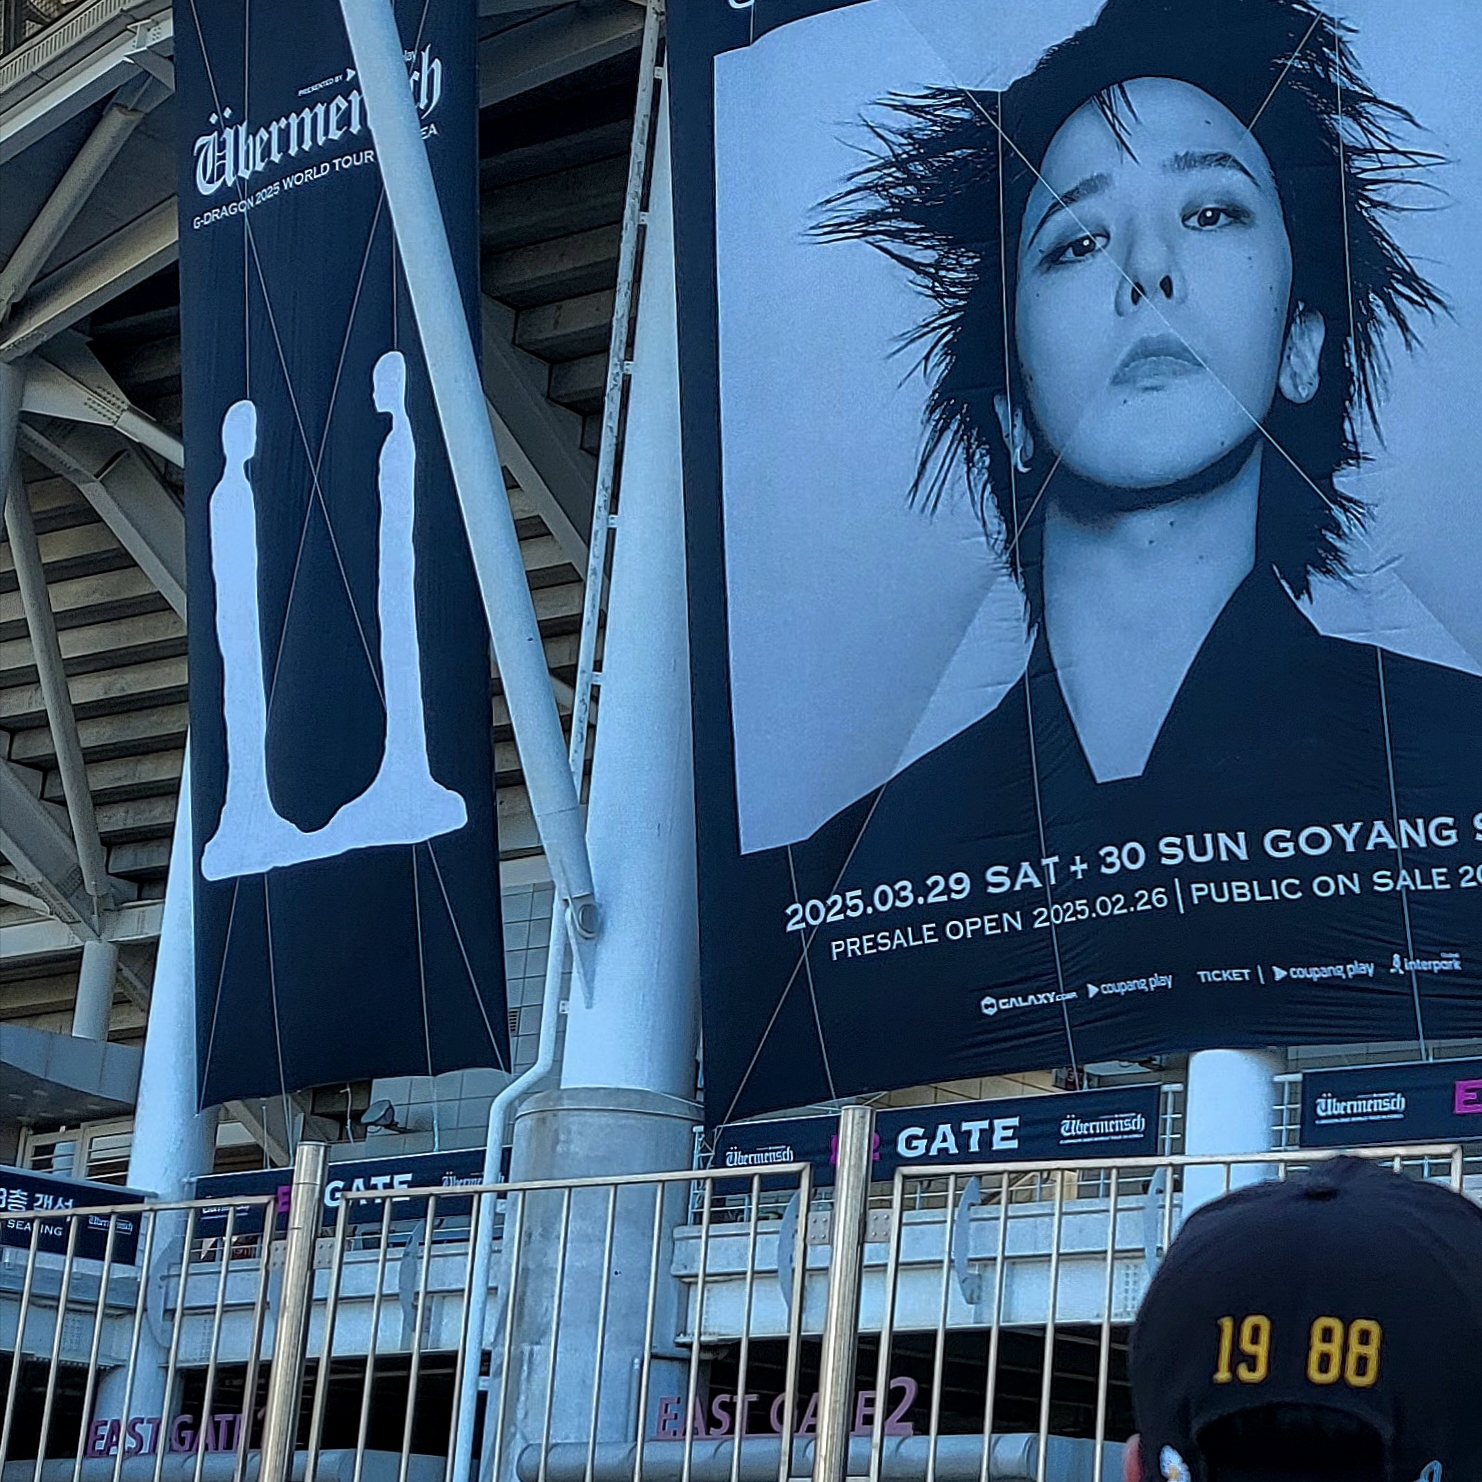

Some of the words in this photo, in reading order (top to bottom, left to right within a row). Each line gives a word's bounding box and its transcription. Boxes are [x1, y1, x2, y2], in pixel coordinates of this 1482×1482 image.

[193, 191, 255, 229] G-DRAGON
[255, 181, 280, 207] 2025
[282, 162, 330, 190] WORLD
[333, 150, 375, 173] TOUR
[785, 872, 971, 932] 2025.03.29
[985, 855, 1060, 894] SAT
[1100, 842, 1146, 876] 30
[1159, 831, 1249, 866] SUN
[1263, 817, 1459, 859] GOYANG
[831, 923, 939, 961] PRESALE
[945, 911, 1023, 941] OPEN
[1032, 887, 1168, 930] 2025.02.26
[1192, 878, 1303, 906] PUBLIC
[1312, 872, 1361, 898] ON
[1373, 867, 1451, 893] SALE
[1100, 978, 1148, 996] coupang
[1149, 972, 1173, 992] play
[1197, 968, 1251, 983] TICKET
[1289, 965, 1345, 982] coupang
[1346, 960, 1375, 979] play
[1403, 957, 1462, 974] interpark
[896, 1116, 1020, 1158] GATE
[323, 1173, 413, 1207] GATE
[7, 1218, 64, 1236] SEAING
[1212, 1313, 1272, 1385] 19
[1306, 1314, 1383, 1388] 88
[884, 1376, 919, 1436] 2
[85, 1414, 163, 1458] EAST
